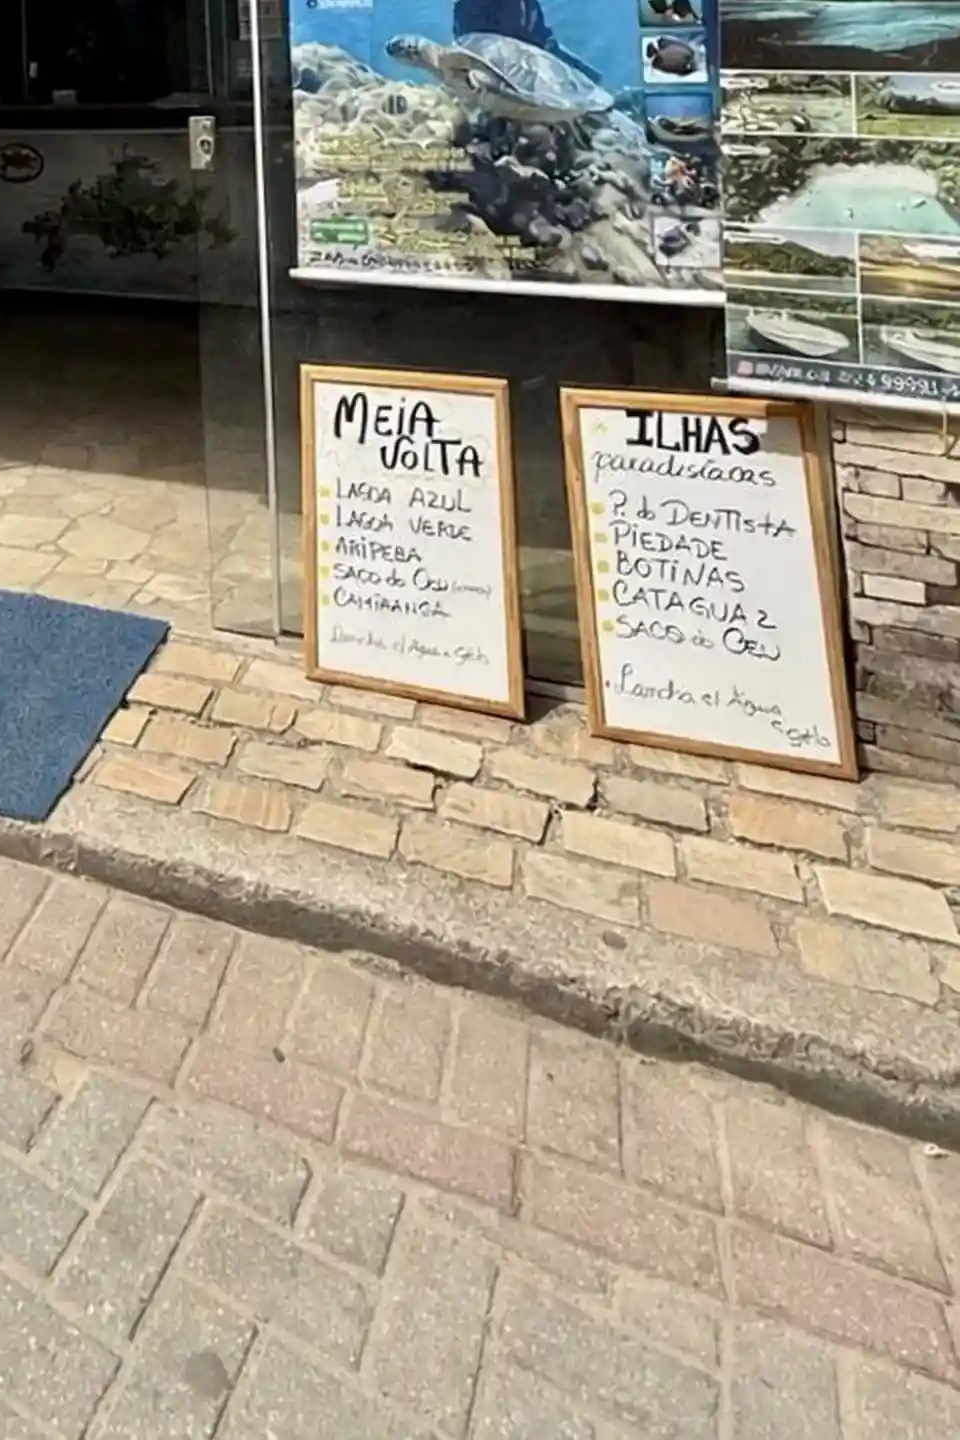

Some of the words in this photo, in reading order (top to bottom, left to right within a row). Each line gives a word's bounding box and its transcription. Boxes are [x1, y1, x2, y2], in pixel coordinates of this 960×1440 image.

[625, 409, 761, 456] ILHAS
[380, 435, 484, 477] VOLTA
[336, 477, 391, 505] LAGOA
[408, 486, 472, 513] AZUL
[408, 515, 473, 542] VERDE
